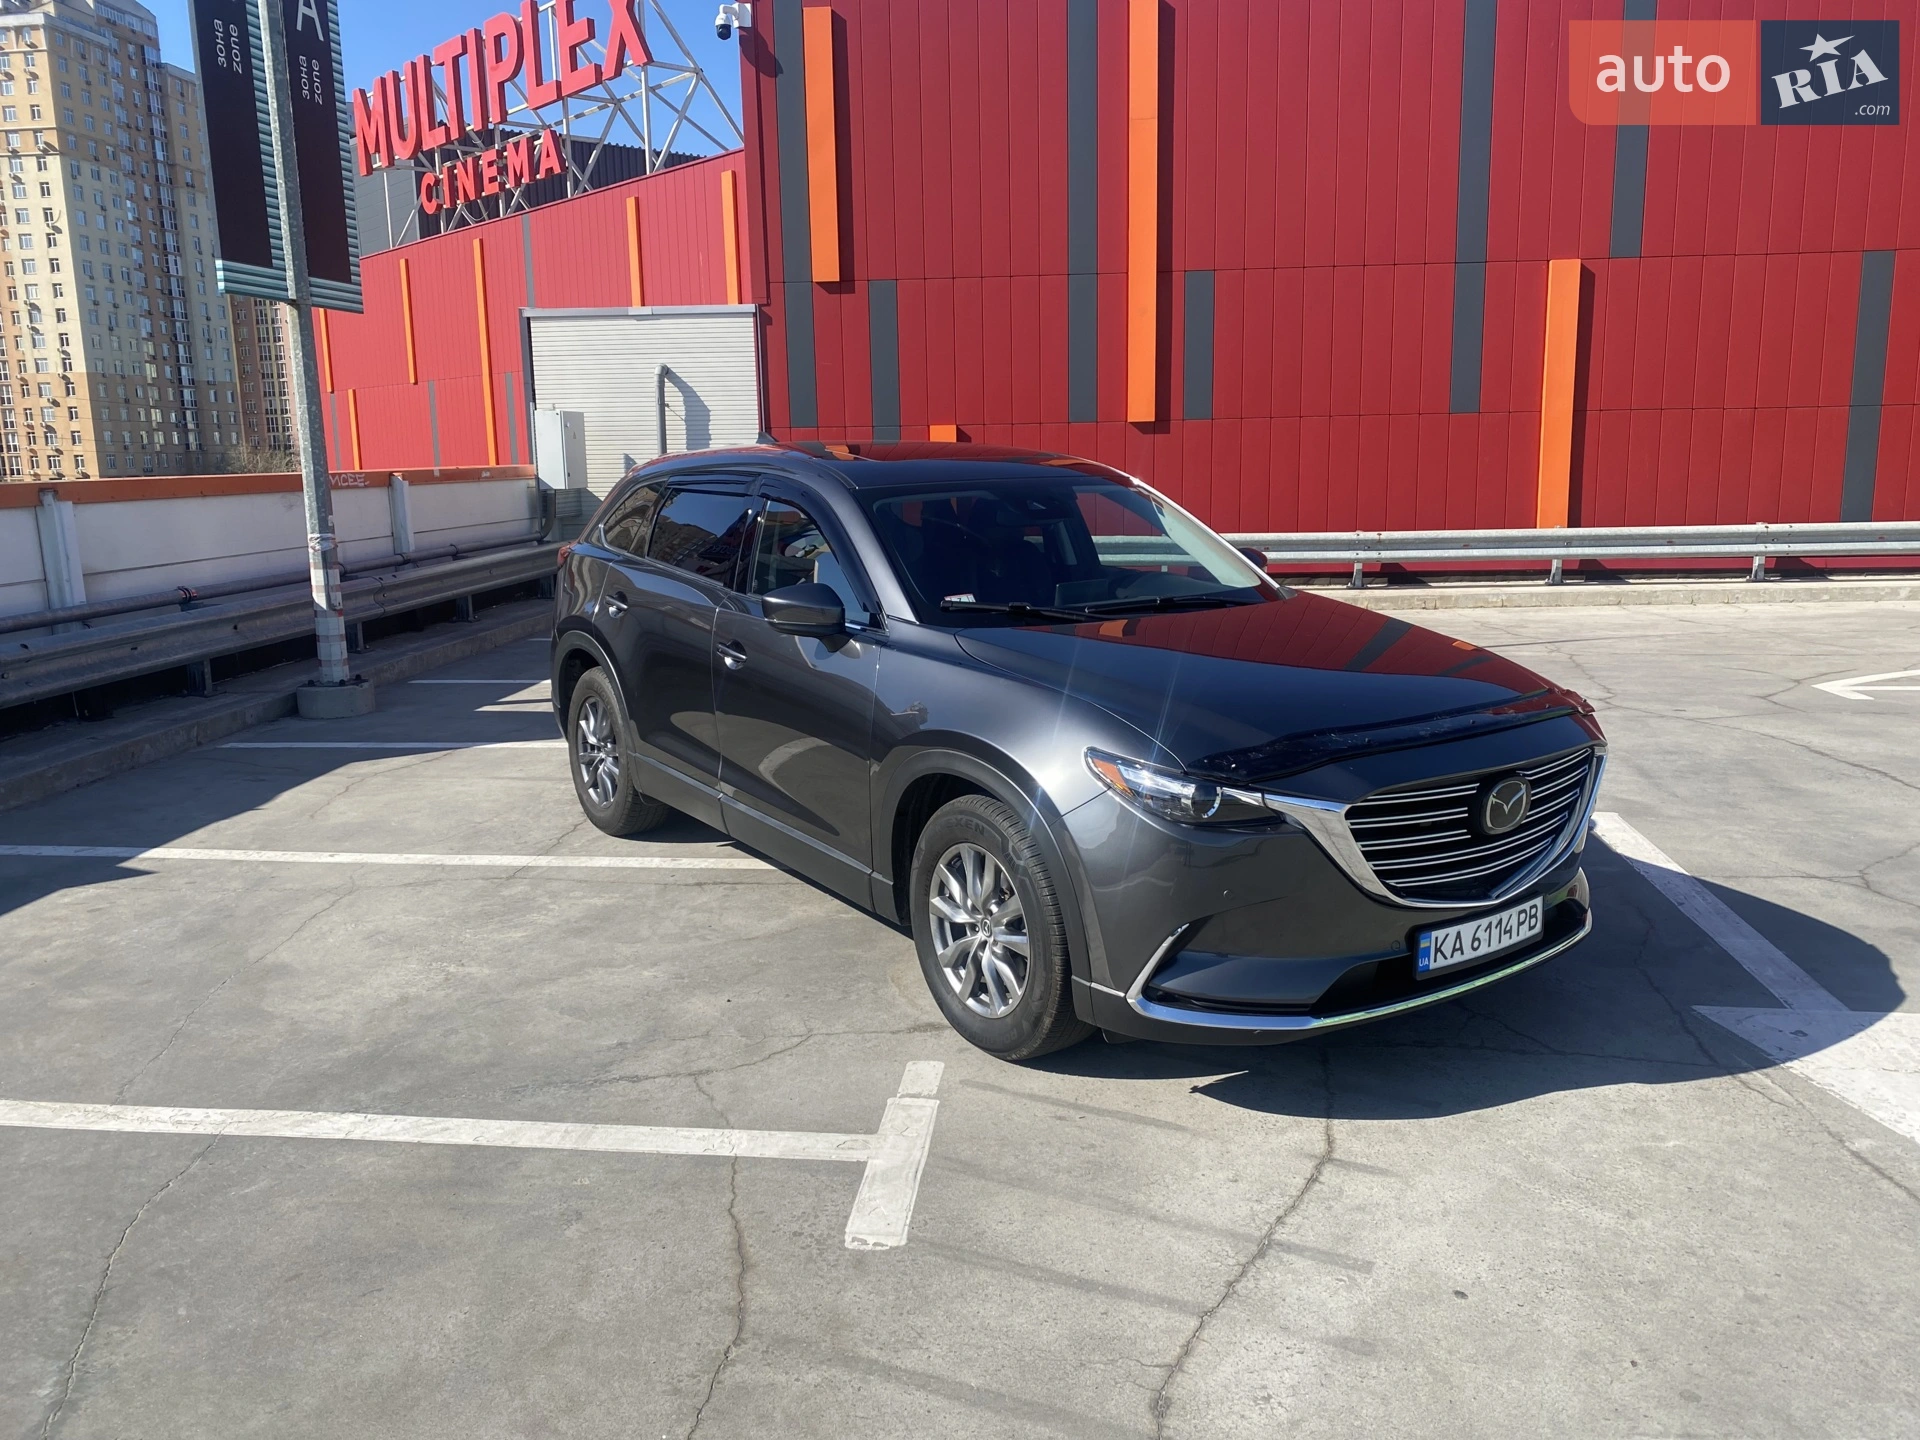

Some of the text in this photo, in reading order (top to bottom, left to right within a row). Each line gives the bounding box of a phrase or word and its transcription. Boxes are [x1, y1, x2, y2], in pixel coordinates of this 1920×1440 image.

[213, 19, 227, 68] зона
[230, 23, 242, 74] zone
[299, 55, 310, 100] зона
[311, 59, 322, 105] zone
[352, 0, 654, 177] MULTIPLEX
[420, 128, 568, 215] CINEMA
[1419, 957, 1429, 967] UA
[1433, 930, 1465, 963] KA
